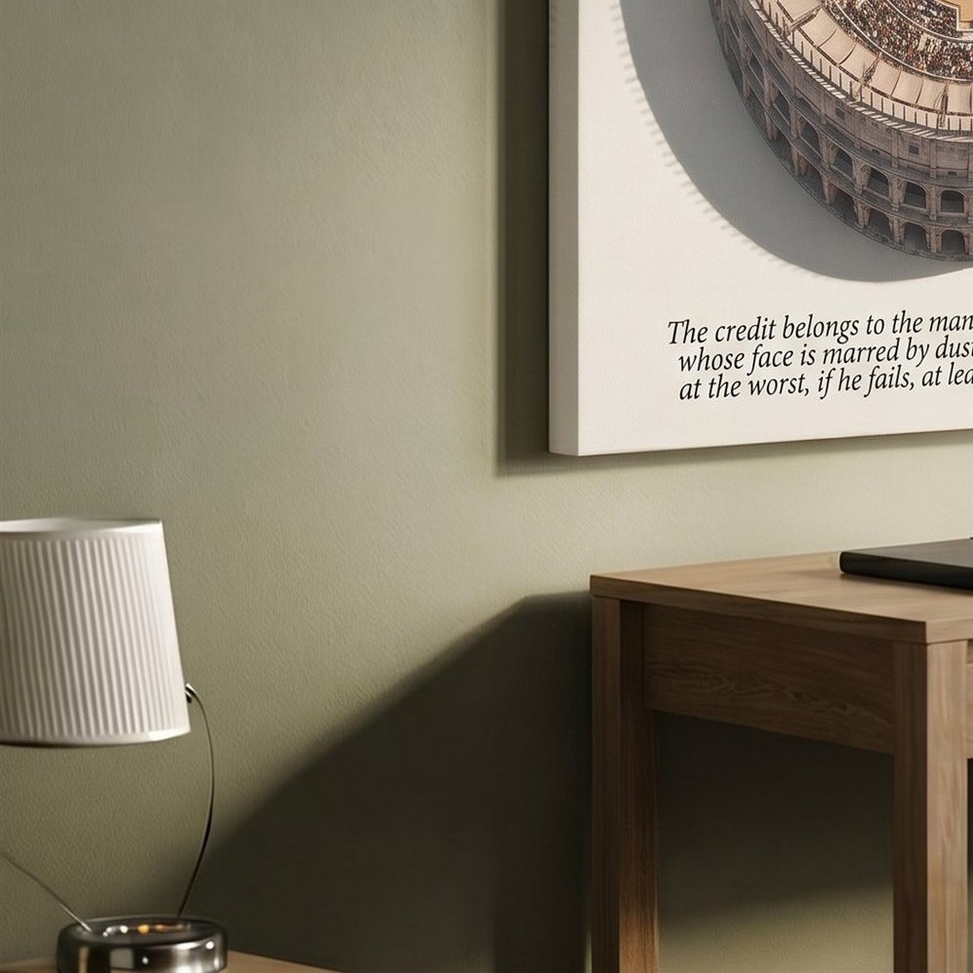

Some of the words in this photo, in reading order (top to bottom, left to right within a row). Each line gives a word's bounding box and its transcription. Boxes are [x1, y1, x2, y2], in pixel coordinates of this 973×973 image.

[668, 319, 708, 345] The
[715, 315, 777, 342] credit
[783, 313, 859, 345] belongs
[866, 315, 885, 335] to
[892, 309, 923, 334] the
[929, 315, 973, 332] man
[678, 346, 745, 372] whose
[748, 343, 794, 376] face
[800, 343, 816, 367] is
[823, 337, 900, 365] marred
[906, 336, 930, 368] by
[679, 378, 702, 400] at
[708, 373, 741, 399] the
[747, 373, 809, 398] worst,
[818, 367, 836, 400] if
[838, 367, 862, 392] he
[863, 364, 914, 398] fails,
[922, 365, 942, 387] at
